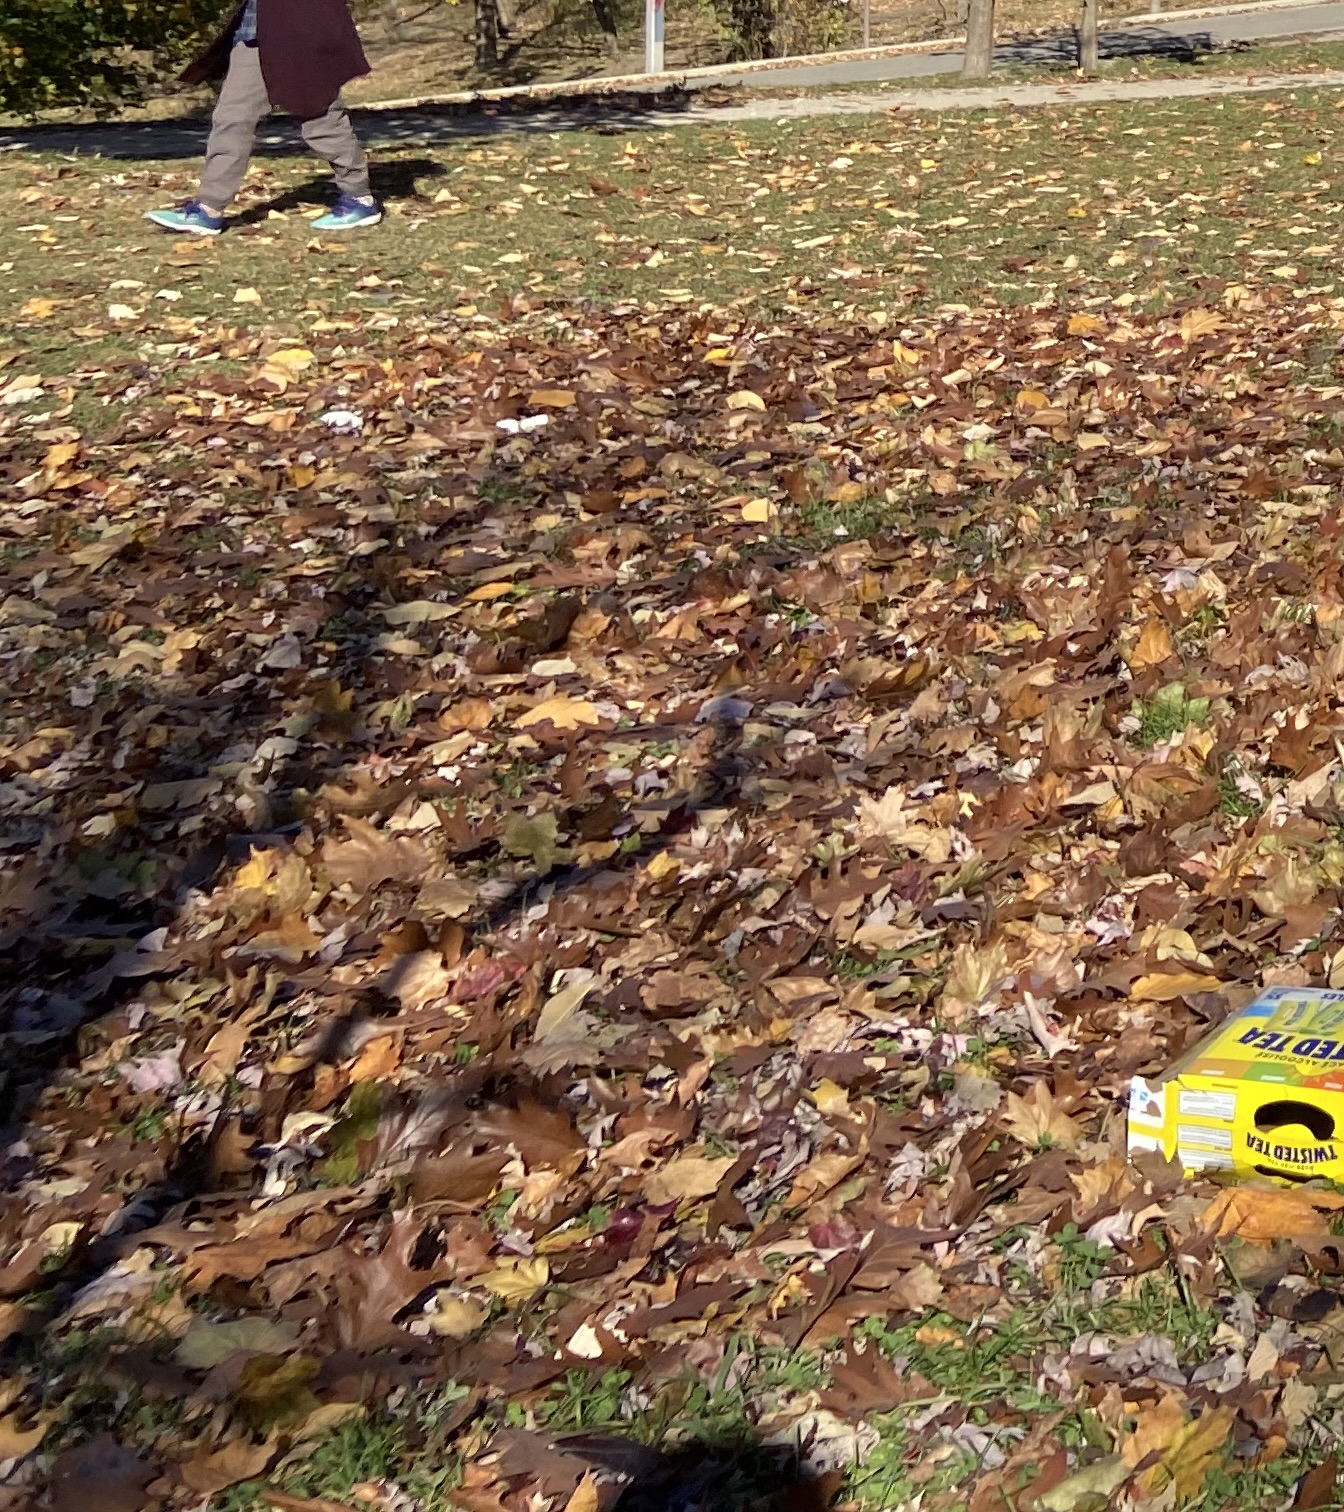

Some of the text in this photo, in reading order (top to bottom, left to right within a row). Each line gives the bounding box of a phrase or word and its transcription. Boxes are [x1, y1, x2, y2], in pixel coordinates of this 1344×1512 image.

[1238, 1027, 1295, 1052] TEA
[1246, 1131, 1271, 1158] TEA
[1273, 1144, 1338, 1164] TWISTED
